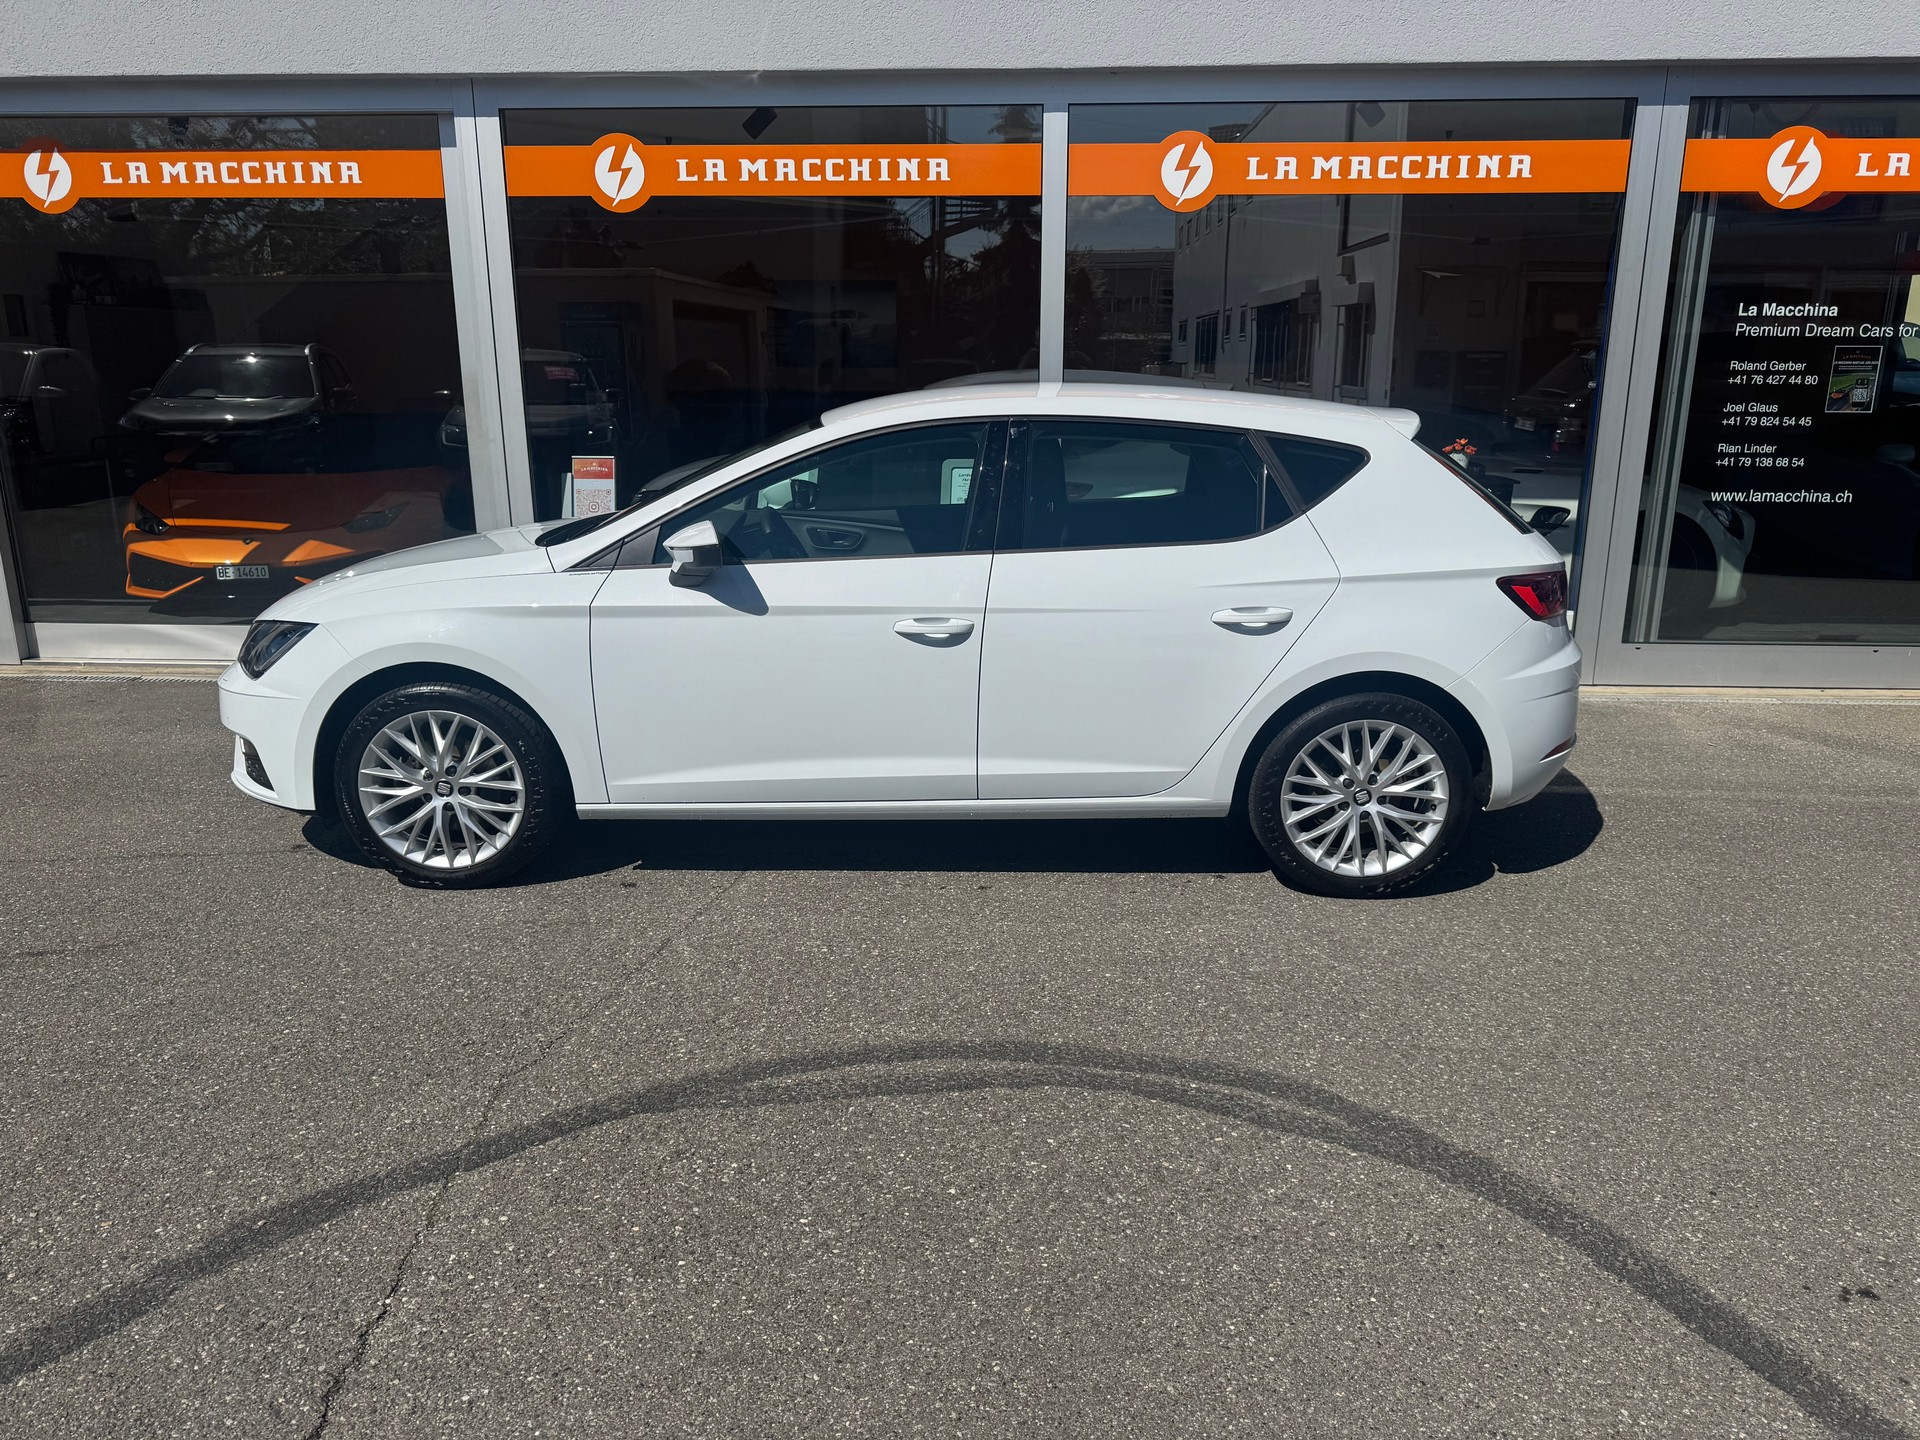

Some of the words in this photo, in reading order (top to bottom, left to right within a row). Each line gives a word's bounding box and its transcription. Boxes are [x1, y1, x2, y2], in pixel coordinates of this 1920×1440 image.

[676, 158, 728, 182] LA
[739, 158, 951, 182] MACCHINA
[1246, 156, 1299, 180] LA
[1311, 154, 1533, 180] MACCHINA
[1855, 152, 1911, 177] LA
[101, 161, 151, 184] LA
[160, 161, 363, 184] MACCHINA
[1738, 302, 1758, 317] La
[1762, 302, 1839, 317] Macchina
[1735, 322, 1800, 337] Premium
[1805, 323, 1855, 337] Dream
[1859, 323, 1894, 338] Cars
[1898, 323, 1919, 338] for
[1729, 360, 1767, 371] Roland
[1769, 360, 1807, 371] Gerber
[1727, 374, 1747, 385] +41
[1751, 374, 1764, 385] 76
[1765, 374, 1787, 385] 427
[1788, 375, 1802, 385] 44
[1804, 375, 1819, 385] 80
[1722, 402, 1745, 413] Joel
[1747, 402, 1779, 413] Glaus
[1721, 416, 1741, 426] +41
[1744, 416, 1758, 426] 79
[1759, 416, 1780, 427] 824
[1782, 416, 1796, 427] 54
[1798, 416, 1812, 427] 45
[1717, 443, 1742, 453] Rian
[1744, 443, 1778, 454] Linder
[1715, 457, 1735, 467] +41
[1738, 457, 1752, 467] 79
[1755, 457, 1773, 467] 138
[1775, 457, 1789, 467] 68
[1791, 457, 1805, 467] 54
[1710, 489, 1853, 503] www.lamacchina.ch
